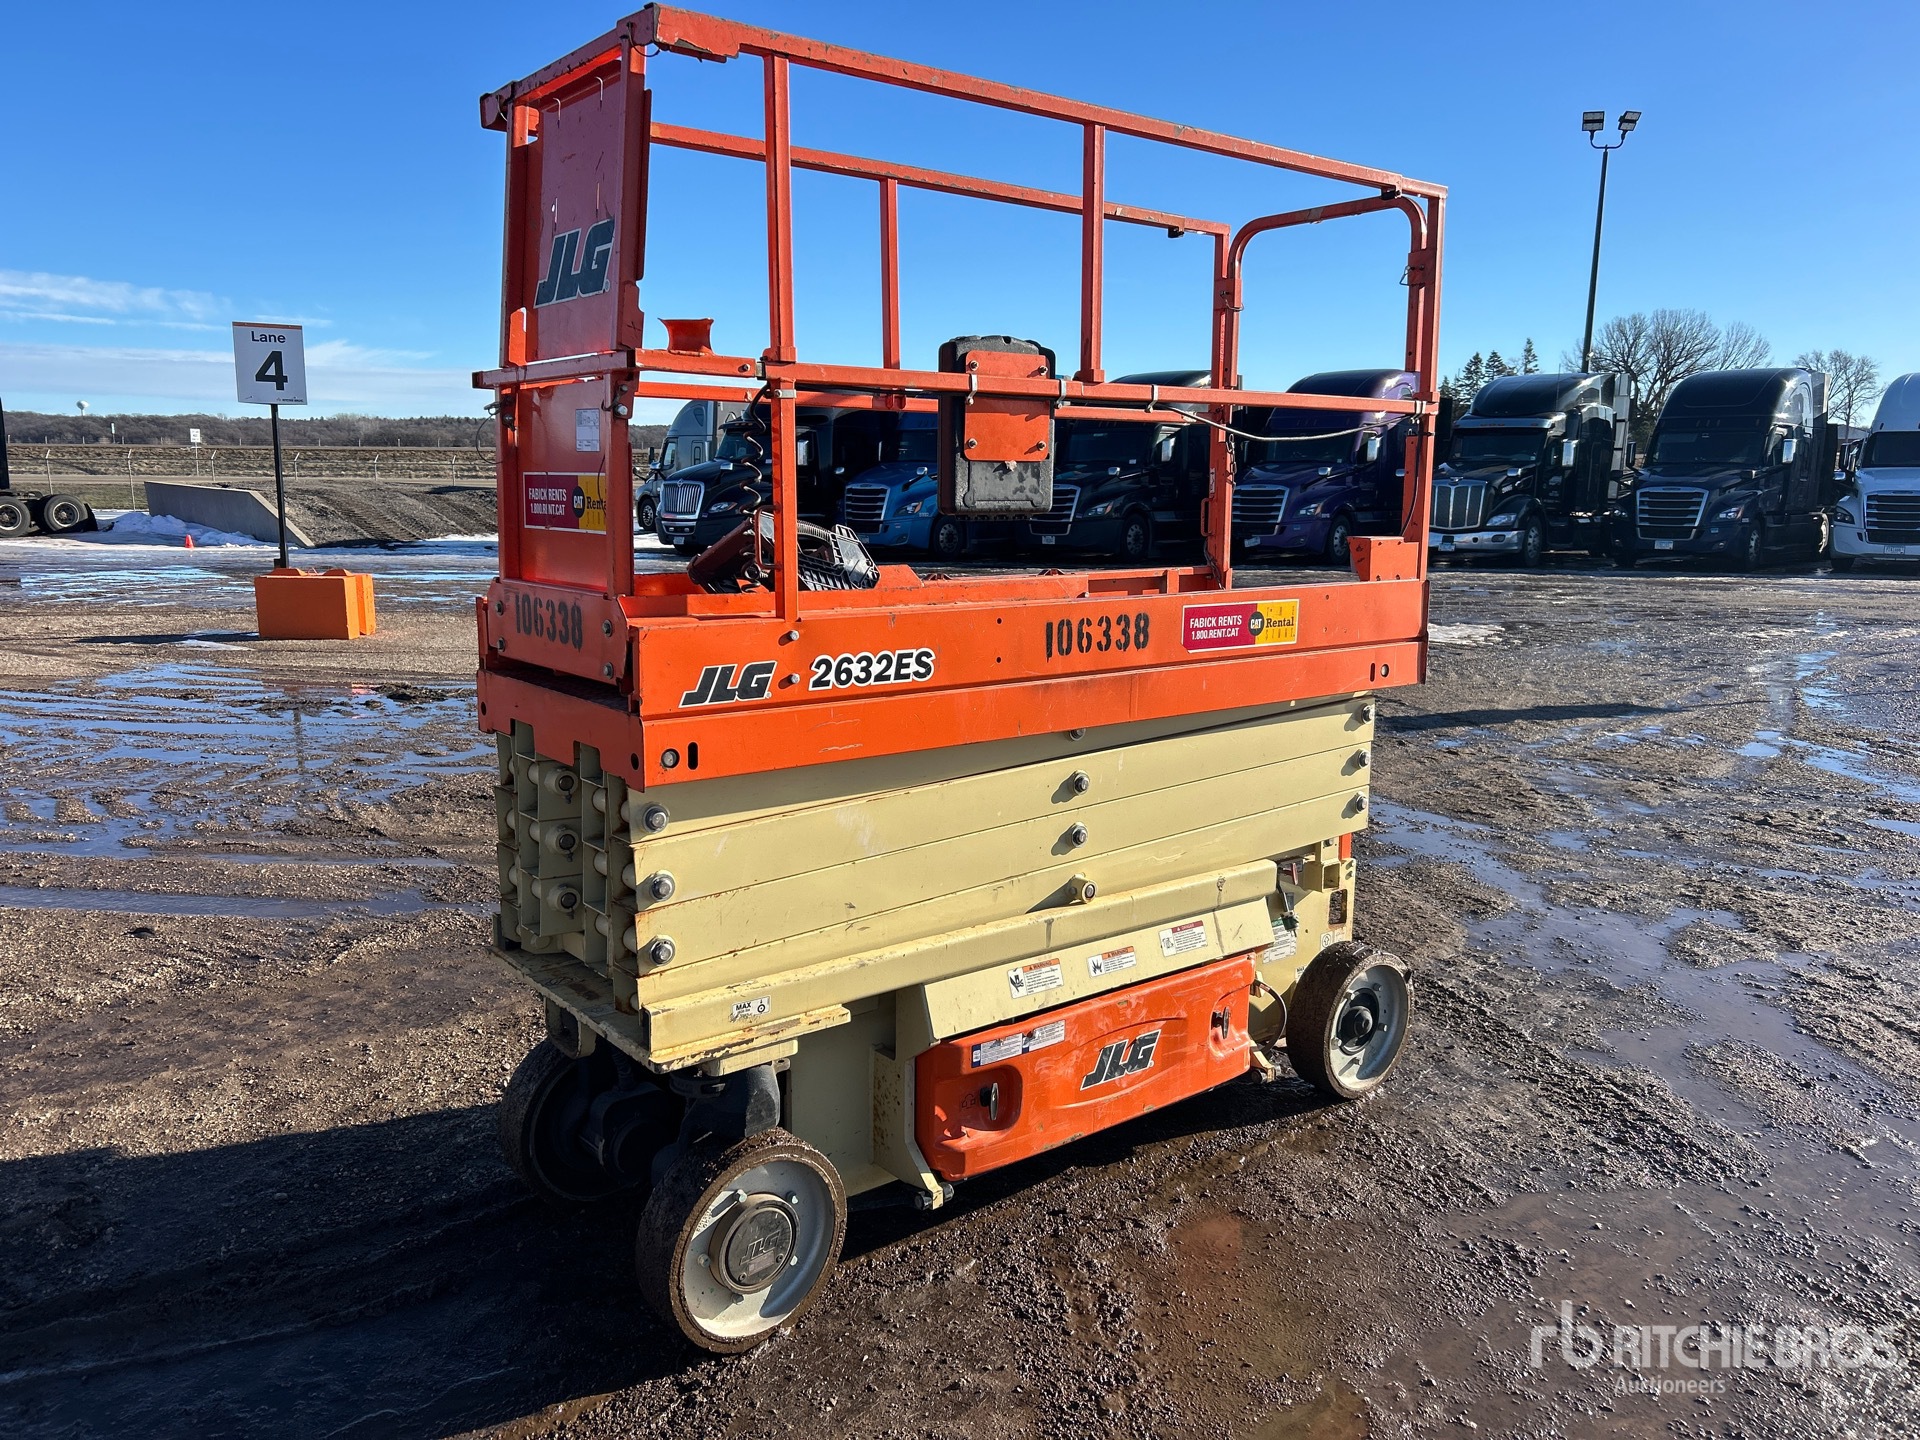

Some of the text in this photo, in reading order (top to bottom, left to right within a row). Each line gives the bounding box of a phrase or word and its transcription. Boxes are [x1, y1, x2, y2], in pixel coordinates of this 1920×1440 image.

[534, 218, 615, 308] JLG
[251, 331, 286, 343] Lane
[255, 350, 288, 391] 4
[528, 488, 567, 501] FABICK RENTS
[573, 495, 583, 509] CAT
[586, 496, 606, 510] Renta
[515, 592, 583, 652] 106338
[1190, 615, 1242, 628] FABICK RENTS
[1250, 618, 1262, 630] CAT
[1265, 617, 1294, 628] Rental
[1046, 613, 1149, 662] 106338
[1191, 628, 1240, 640] 1.800.RENT.CAT
[808, 648, 936, 691] 2632ES
[679, 661, 777, 708] JLG
[735, 1002, 751, 1011] MAX
[1080, 1029, 1162, 1091] JLG
